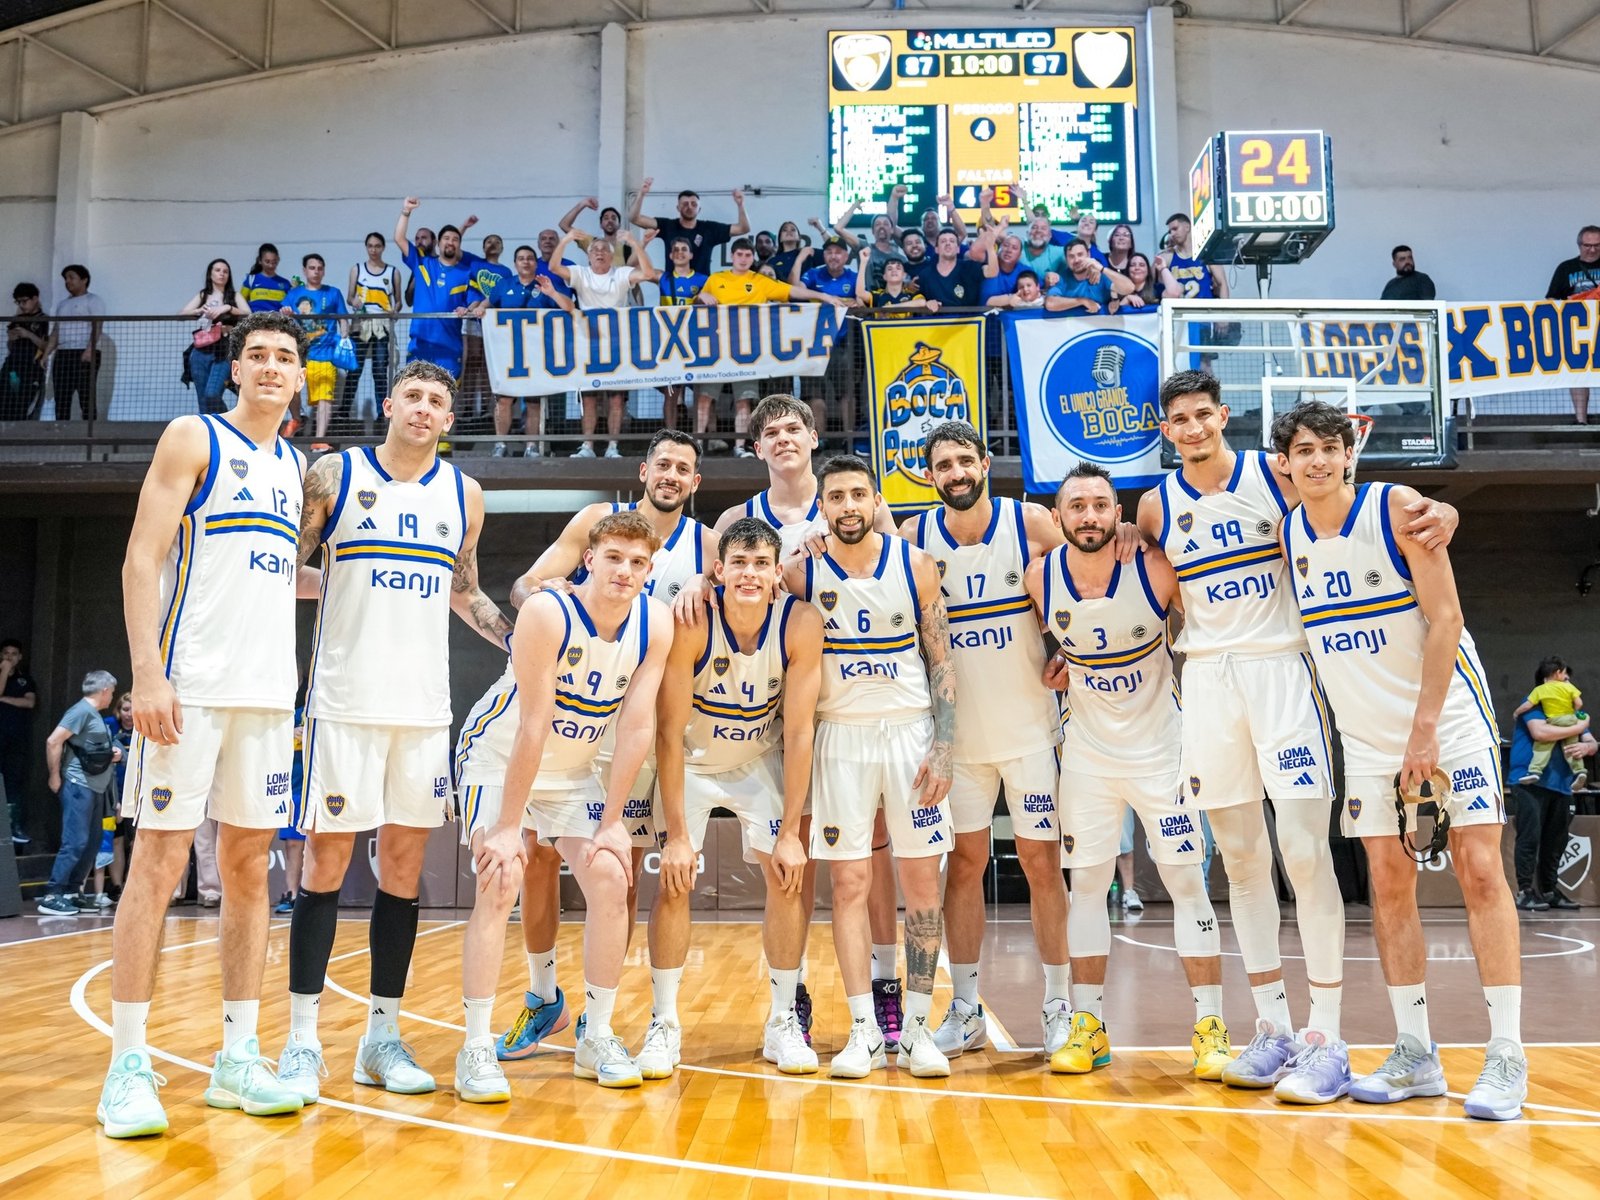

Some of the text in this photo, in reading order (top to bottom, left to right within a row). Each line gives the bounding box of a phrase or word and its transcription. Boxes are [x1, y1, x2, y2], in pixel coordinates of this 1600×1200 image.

[950, 55, 1013, 76] 10:00
[1031, 54, 1061, 75] 97
[974, 119, 991, 140] 4
[1240, 138, 1312, 185] 24
[957, 168, 1013, 182] FALTAS
[1192, 153, 1211, 218] 24
[959, 186, 976, 208] 4
[994, 186, 1011, 206] 5
[1235, 194, 1322, 222] 10:00
[480, 276, 497, 288] CAB
[1499, 299, 1600, 378] BOC
[887, 380, 965, 428] BOCA
[1059, 386, 1130, 414] EL UNICO GRANDE
[1080, 402, 1160, 439] BOCA
[1401, 438, 1435, 446] STADIUM
[272, 487, 288, 517] 12
[398, 513, 418, 538] 19
[1211, 519, 1244, 548] 99
[250, 550, 294, 586] kanj
[966, 573, 986, 599] 17
[1323, 570, 1352, 598] 20
[857, 609, 871, 634] 6
[1092, 627, 1108, 651] 3
[587, 670, 603, 696] 9
[741, 681, 755, 703] 4
[1277, 746, 1311, 761] LOMA
[1279, 755, 1316, 771] NEGRA
[1024, 793, 1052, 805] LOMA
[1024, 802, 1055, 814] NEGRA
[769, 819, 783, 829] LO
[911, 805, 940, 821] LOMA
[913, 814, 943, 830] NEGRA
[1160, 814, 1190, 828] LOMA
[1161, 823, 1195, 838] NEGRA
